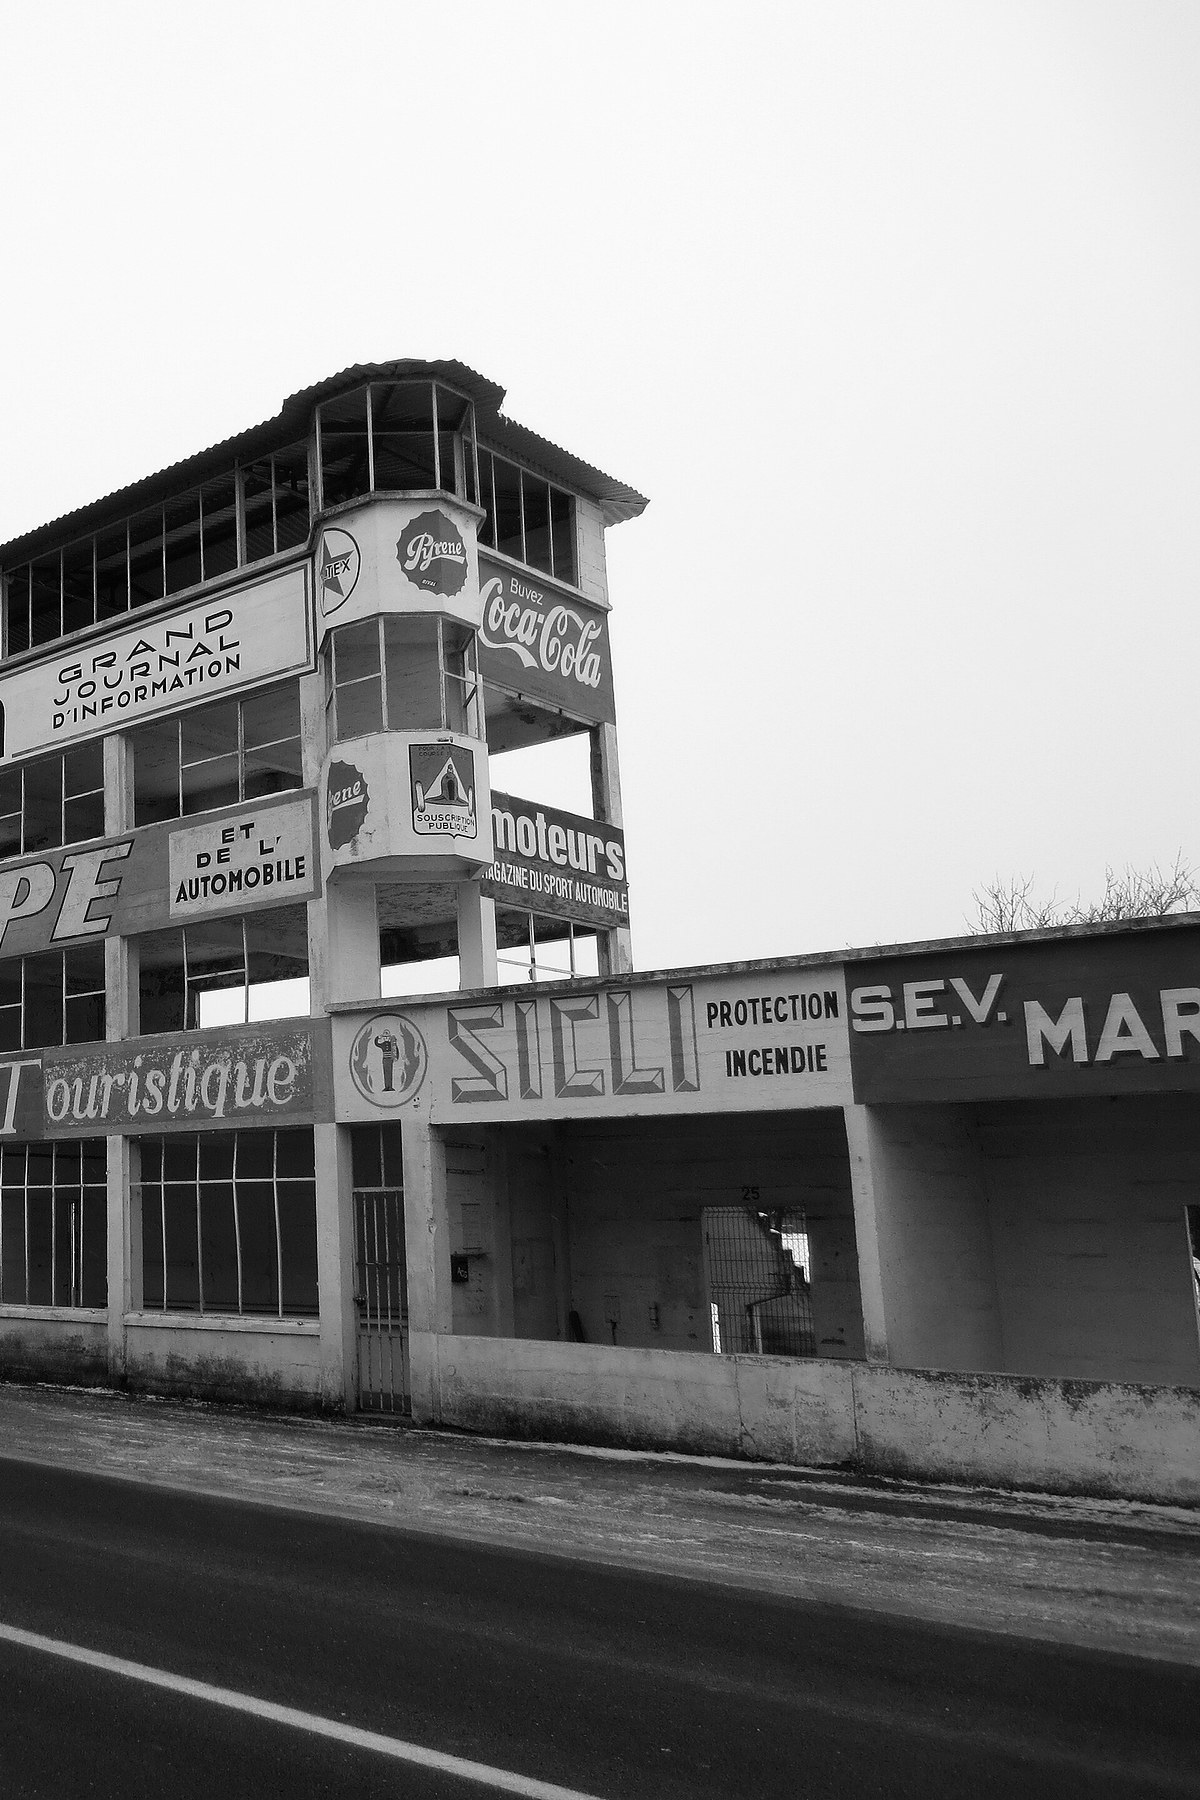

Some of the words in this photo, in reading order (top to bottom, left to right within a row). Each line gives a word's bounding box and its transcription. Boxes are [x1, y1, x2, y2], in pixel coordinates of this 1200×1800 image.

[404, 532, 465, 571] Pyrene
[510, 577, 543, 605] Buvez
[58, 609, 233, 684] GRAND
[478, 577, 602, 688] Coca-Cola
[53, 635, 240, 706] JOURNAL
[52, 653, 240, 729] D'INFORMATION
[330, 781, 361, 806] ene
[221, 822, 255, 844] ET
[416, 813, 475, 827] SOUSCRIPTION
[428, 822, 468, 833] PUBLIQUE
[196, 847, 231, 869] DE
[259, 835, 282, 855] L'
[491, 808, 625, 881] moteurs
[175, 856, 306, 903] AUTOMOBILE
[529, 869, 543, 892] DU
[544, 873, 574, 900] SPORT
[706, 990, 840, 1029] PROTECTION
[851, 973, 1007, 1033] S.E.V.
[1023, 986, 1200, 1066] MAR
[447, 984, 701, 1103] SICLI
[725, 1044, 828, 1078] INCENDIE
[741, 1185, 760, 1200] 25
